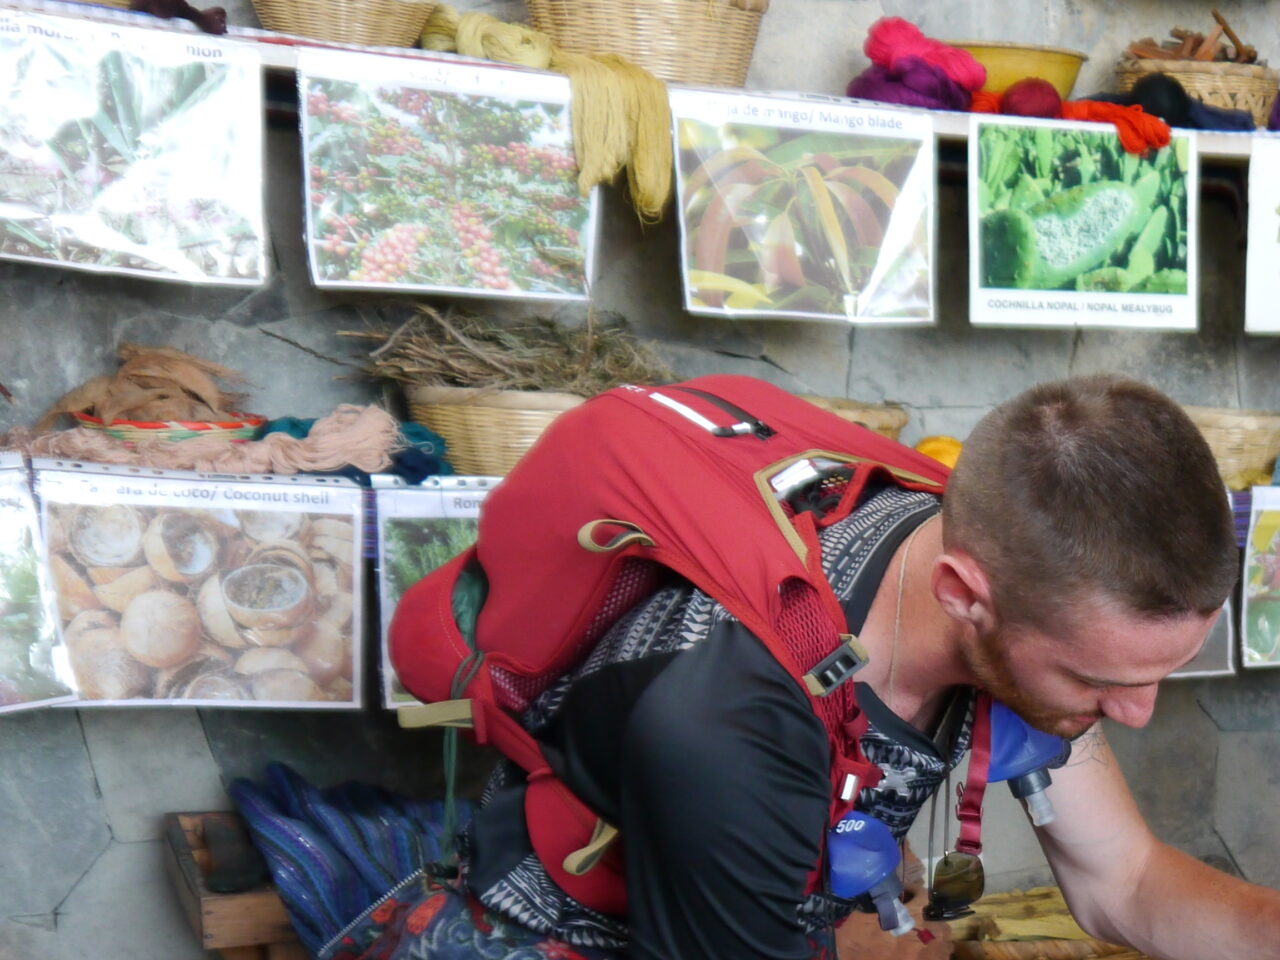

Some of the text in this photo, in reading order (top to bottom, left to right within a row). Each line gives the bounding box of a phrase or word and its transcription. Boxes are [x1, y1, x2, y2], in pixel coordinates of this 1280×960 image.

[818, 110, 864, 128] Mango
[867, 113, 903, 130] blade
[1046, 301, 1080, 312] NOPAL
[1086, 302, 1119, 313] NOPAL
[1121, 304, 1174, 315] MEALYBUG
[223, 486, 289, 503] Coconut
[836, 819, 865, 833] 500
